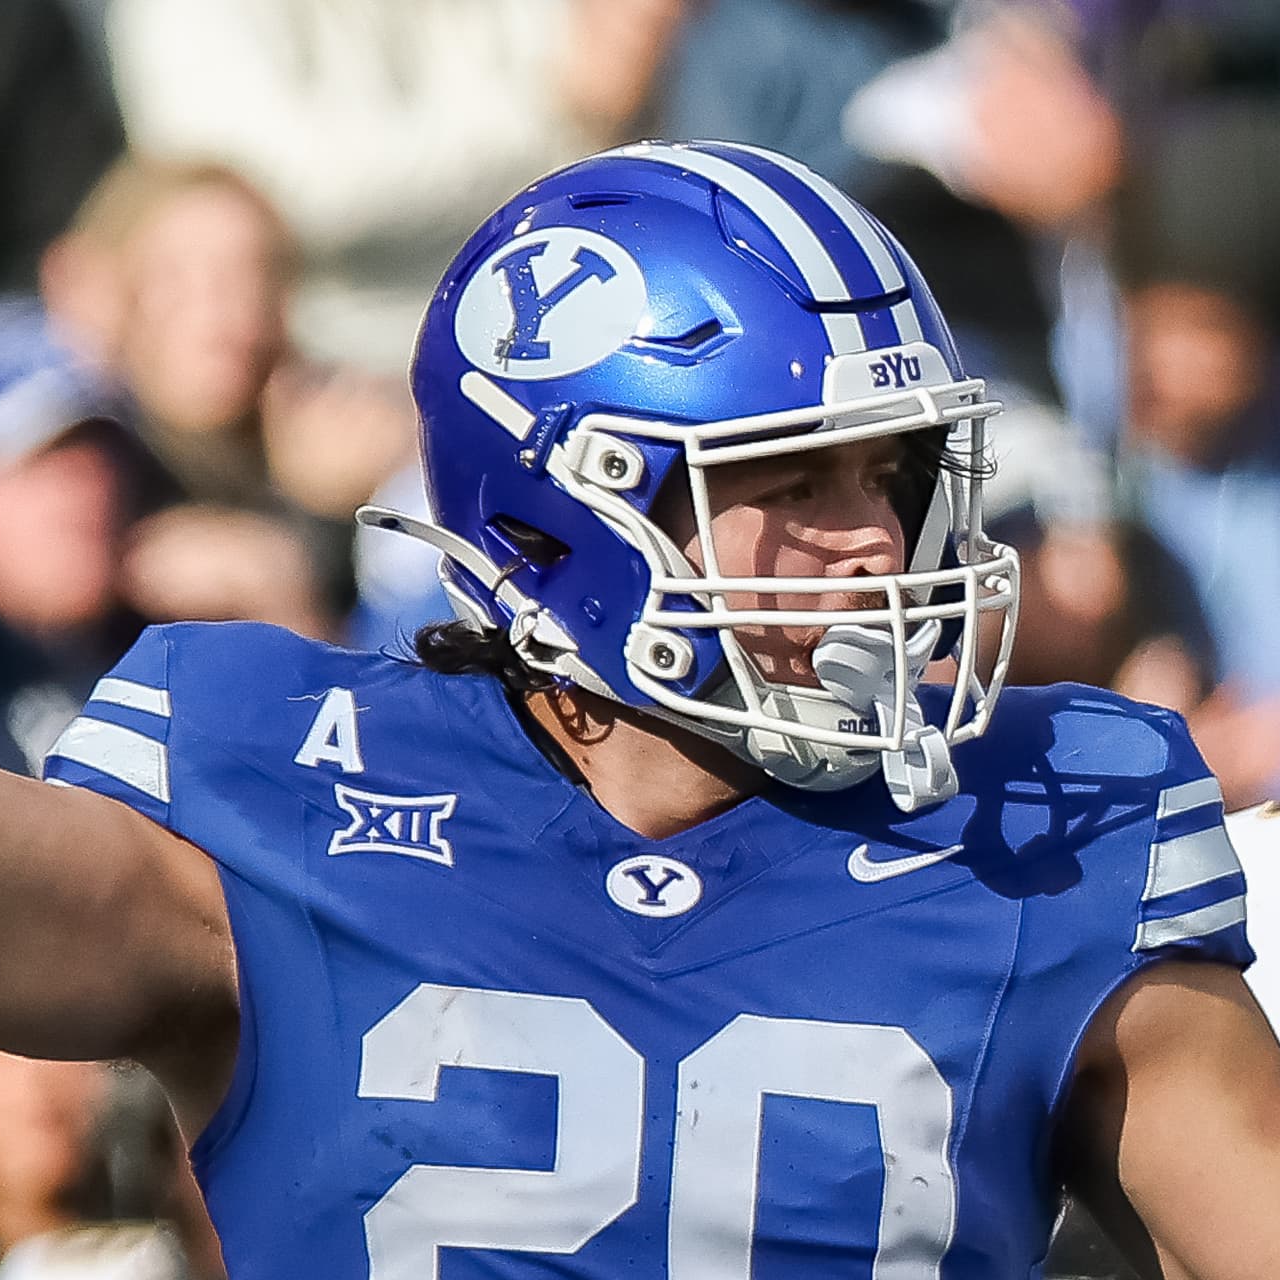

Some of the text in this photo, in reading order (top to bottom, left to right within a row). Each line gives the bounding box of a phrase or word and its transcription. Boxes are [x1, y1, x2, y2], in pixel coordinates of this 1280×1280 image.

[491, 240, 617, 361] Y
[868, 352, 921, 388] BYU
[294, 687, 365, 774] A
[622, 864, 684, 906] Y
